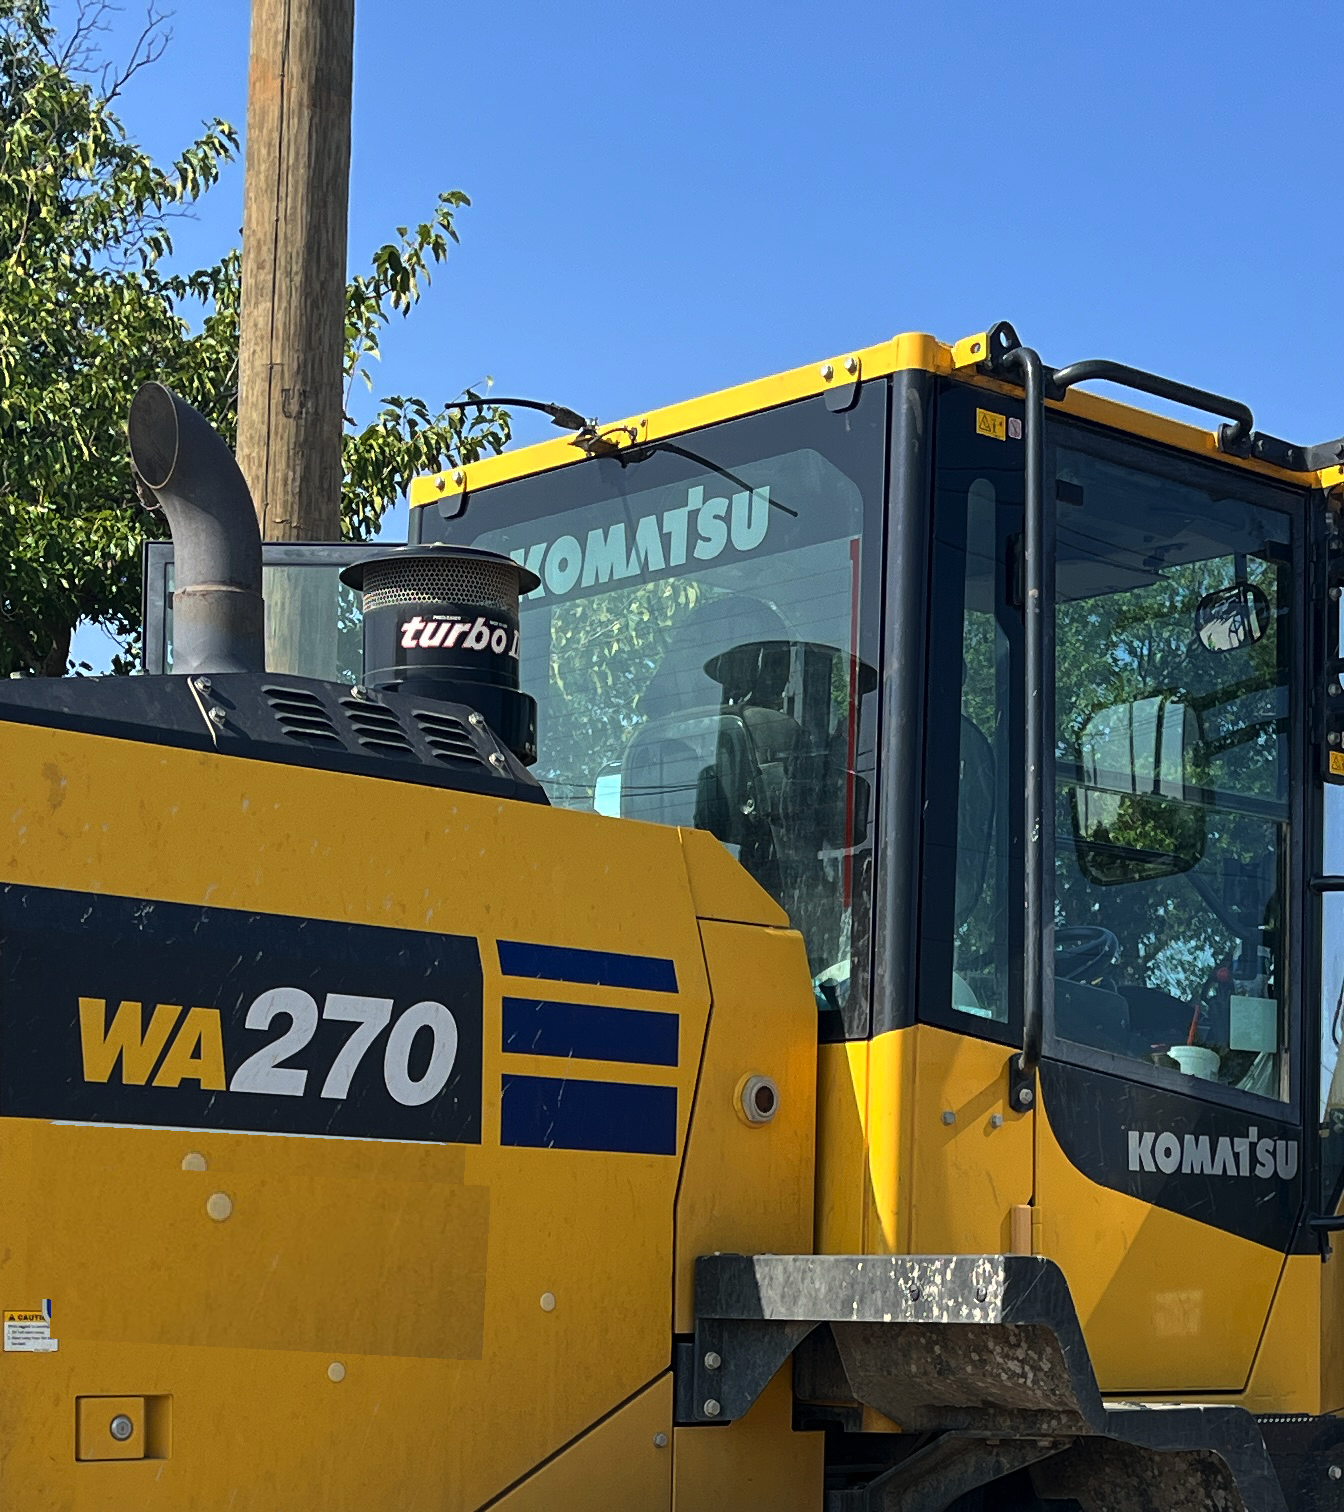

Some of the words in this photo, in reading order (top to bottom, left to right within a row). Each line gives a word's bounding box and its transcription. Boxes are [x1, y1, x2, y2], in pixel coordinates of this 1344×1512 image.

[510, 486, 770, 602] KOMATSU
[401, 616, 507, 654] turbo
[78, 986, 458, 1106] WA270
[1128, 1127, 1298, 1180] KOMATSU
